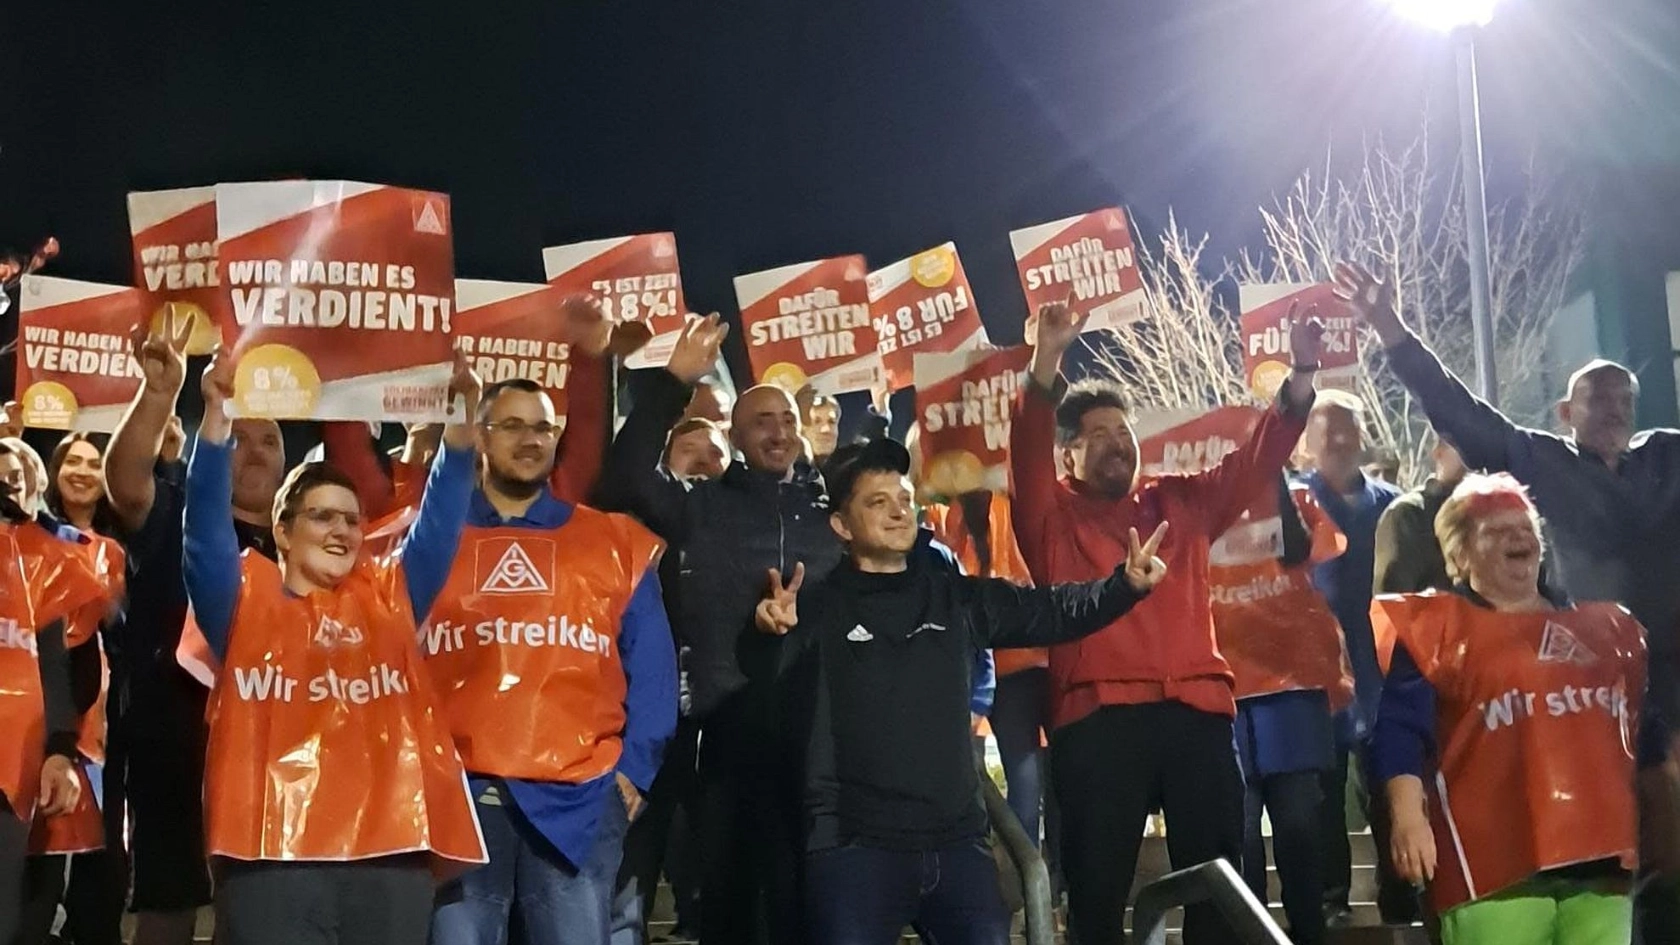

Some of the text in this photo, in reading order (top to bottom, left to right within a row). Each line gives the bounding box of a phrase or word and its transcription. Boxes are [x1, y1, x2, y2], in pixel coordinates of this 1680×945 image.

[228, 259, 416, 290] WIR HABEN ES
[1026, 247, 1133, 290] STREITEN
[1073, 272, 1122, 301] WIR
[231, 286, 452, 334] VERDIENT!
[917, 286, 969, 323] FÜR
[24, 326, 59, 345] WIR
[63, 331, 123, 351] HABEN
[750, 302, 871, 346] STREITEN
[478, 337, 543, 357] HABEN
[546, 342, 569, 360] ES
[801, 330, 856, 360] WIR
[474, 615, 611, 658] streiken
[235, 663, 298, 702] Wir
